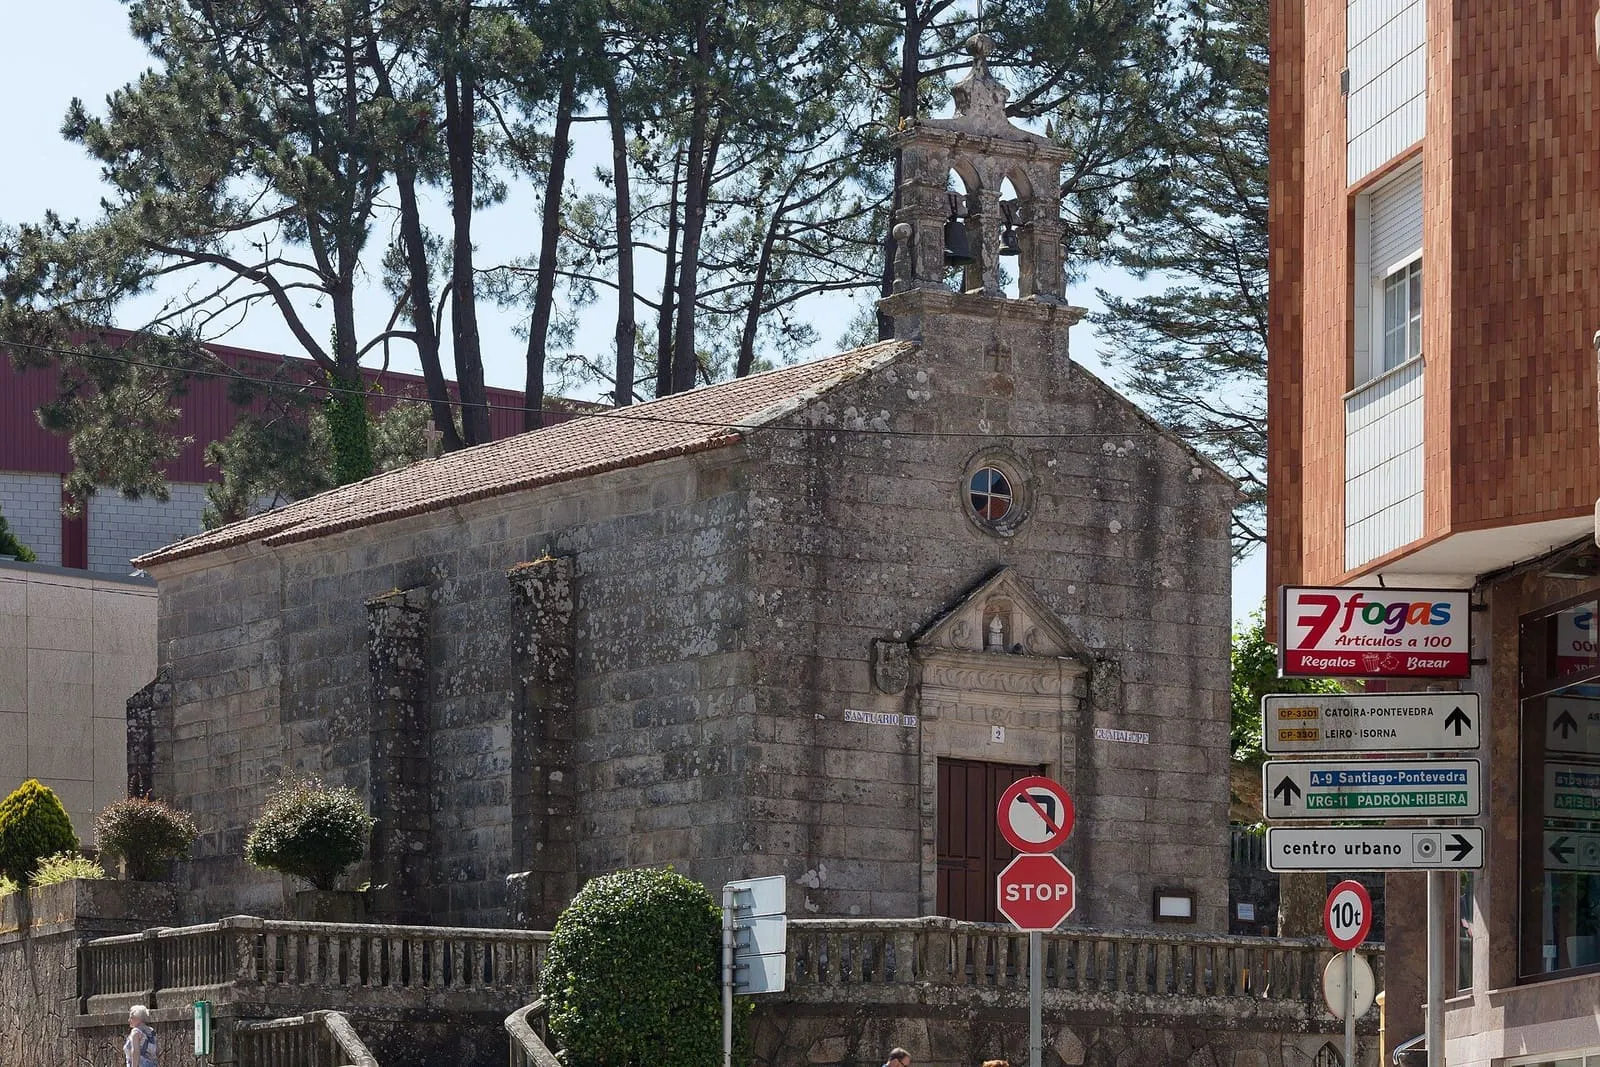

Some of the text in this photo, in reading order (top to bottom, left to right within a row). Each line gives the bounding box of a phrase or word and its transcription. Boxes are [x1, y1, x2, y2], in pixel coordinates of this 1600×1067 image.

[1296, 593, 1451, 649] 7 fogas
[1335, 635, 1452, 648] Artículos a 100
[1301, 655, 1450, 671] Regalos Bazar
[845, 710, 899, 724] SANTUARIO
[1280, 707, 1434, 718] CP-3301 CATOIRA-PONTEVEDRA
[1325, 729, 1353, 739] LEIRO
[1360, 728, 1397, 738] ISORNA
[1311, 771, 1466, 785] A-9 Santiago-Pontevedra
[1308, 791, 1467, 807] VRG-11 PADRÓN-RIBEIRA
[1283, 840, 1402, 855] centro urbano
[1005, 883, 1068, 901] STOP
[1331, 902, 1361, 929] 10t
